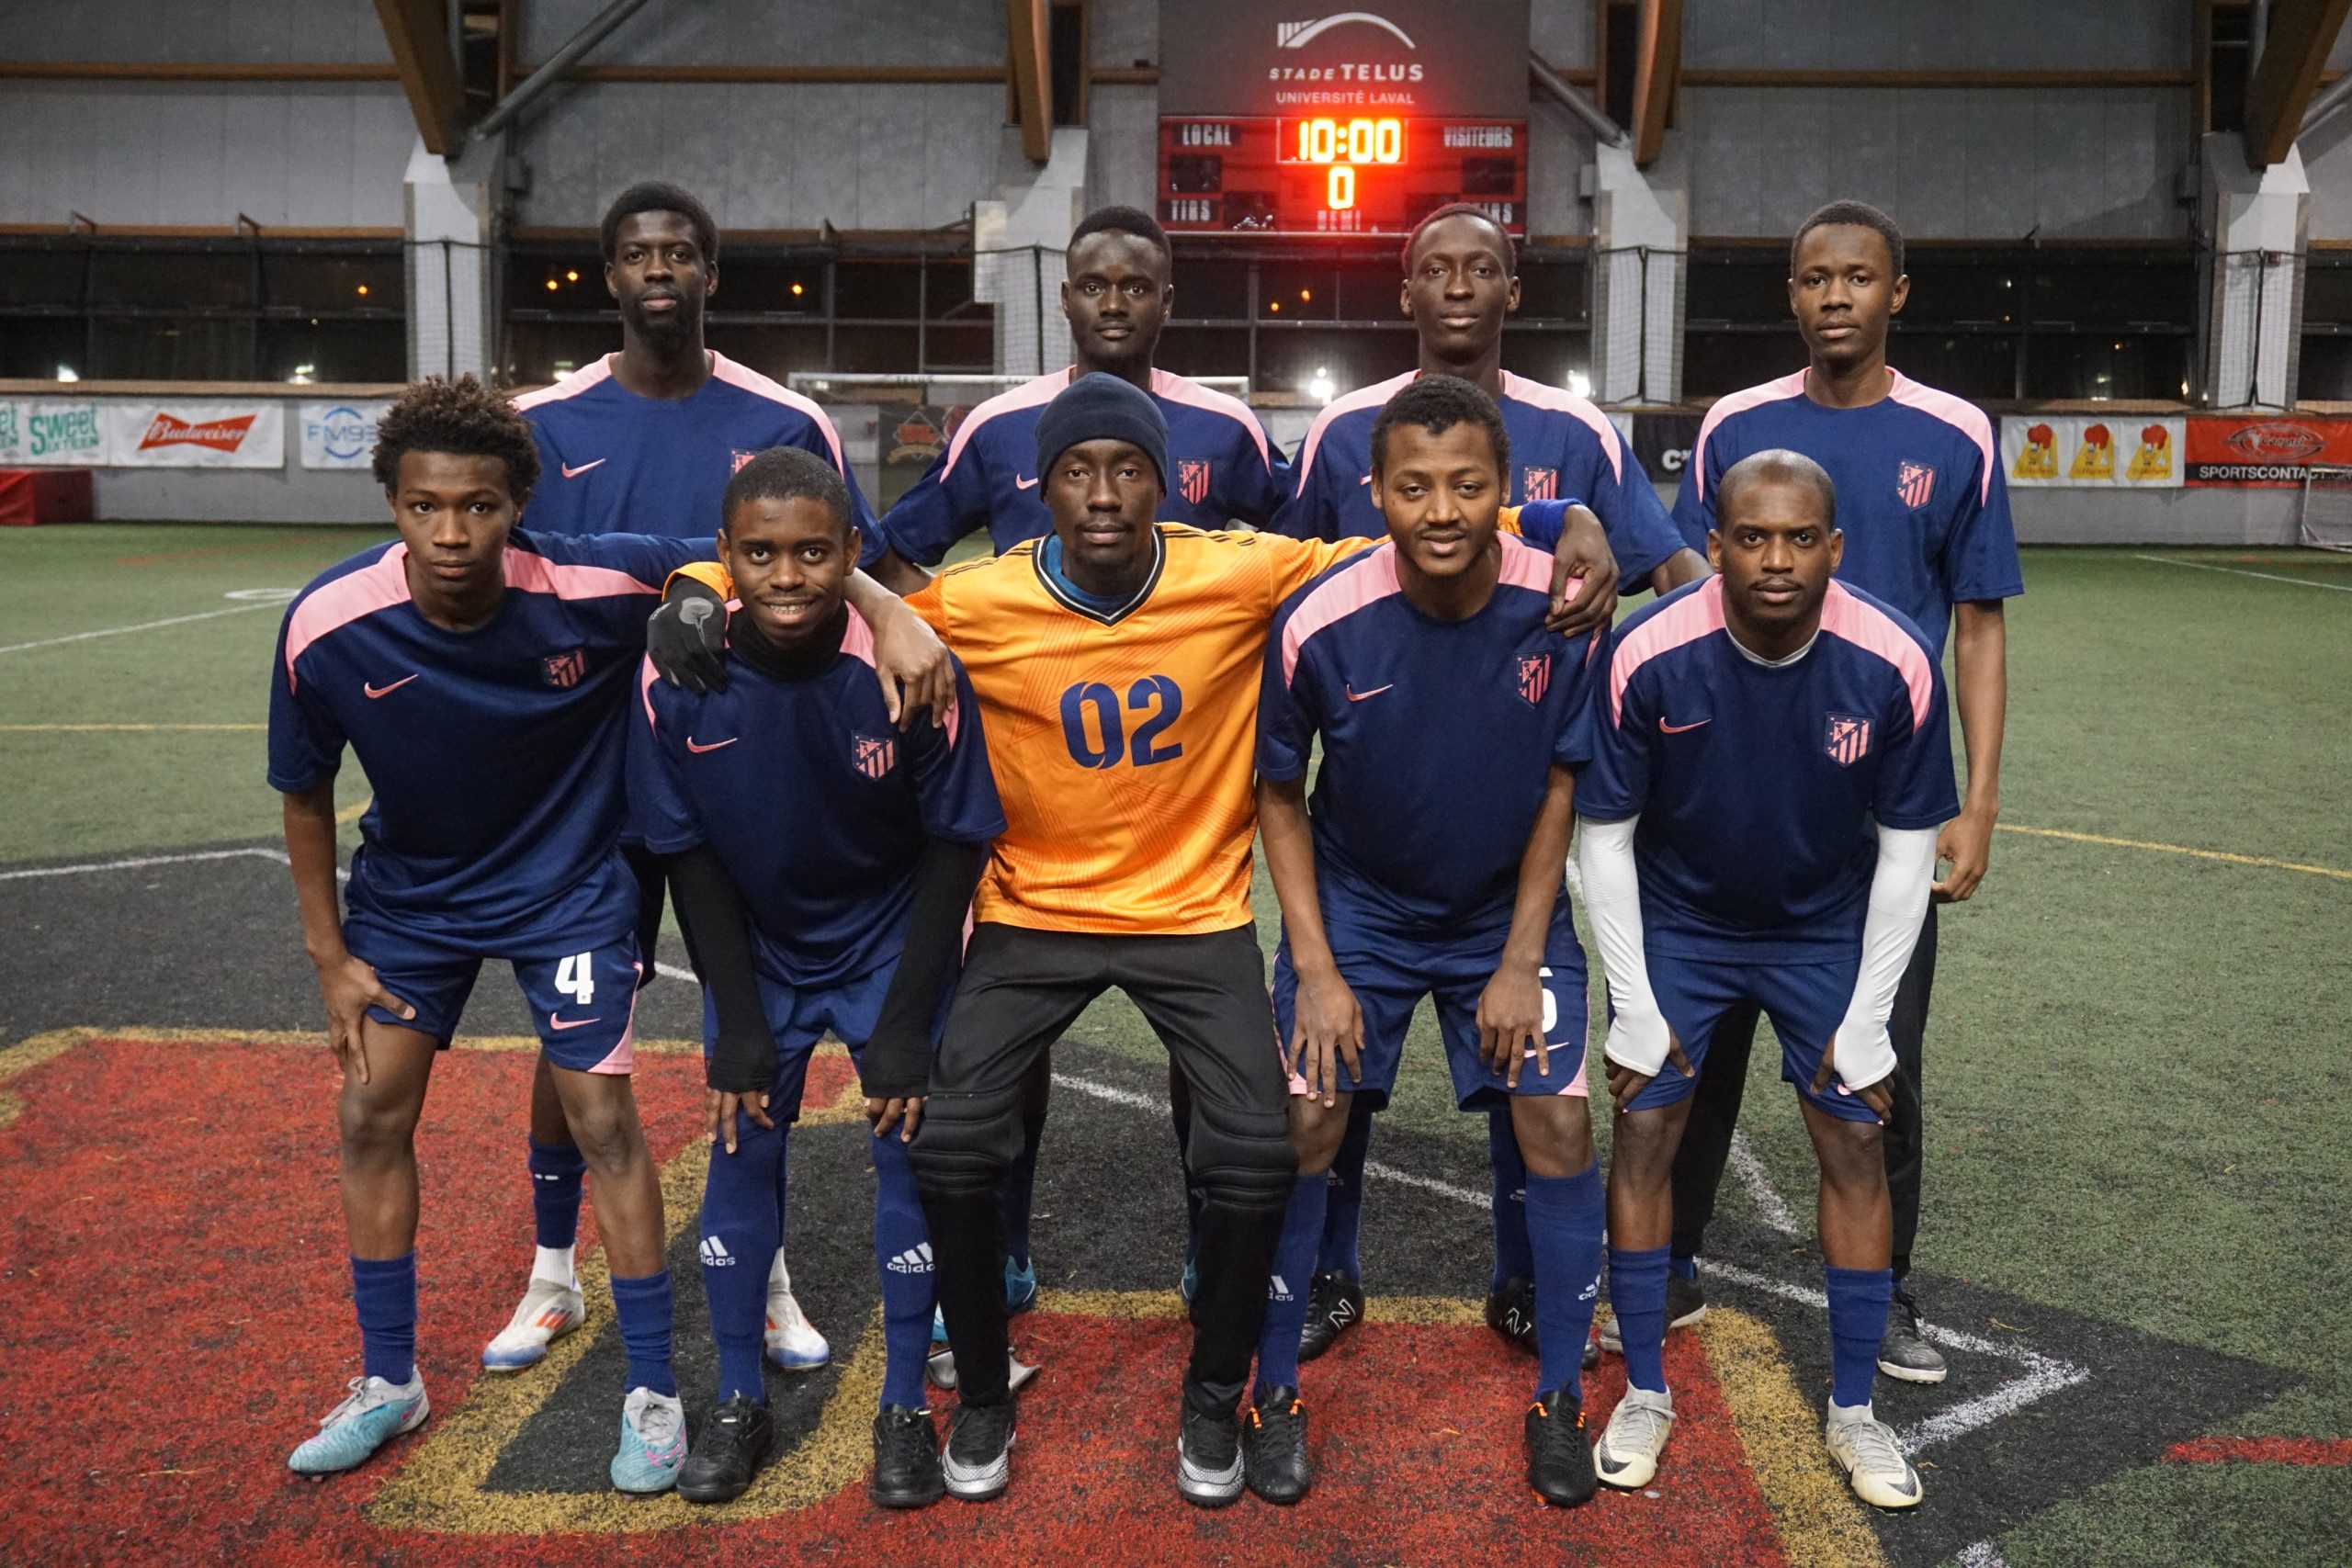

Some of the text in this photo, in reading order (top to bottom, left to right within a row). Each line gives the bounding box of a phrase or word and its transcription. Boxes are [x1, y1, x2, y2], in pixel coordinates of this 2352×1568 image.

[1269, 63, 1424, 82] STADE TELUS
[1276, 90, 1415, 104] UNIVERSITÉ LAVAL
[1182, 123, 1231, 146] LOCAL
[1298, 118, 1402, 164] 10:00
[1443, 126, 1513, 148] VISITEURS
[1328, 166, 1355, 210] 0
[147, 421, 246, 442] Budweiser
[1060, 674, 1182, 770] 02
[554, 952, 594, 1004] 4
